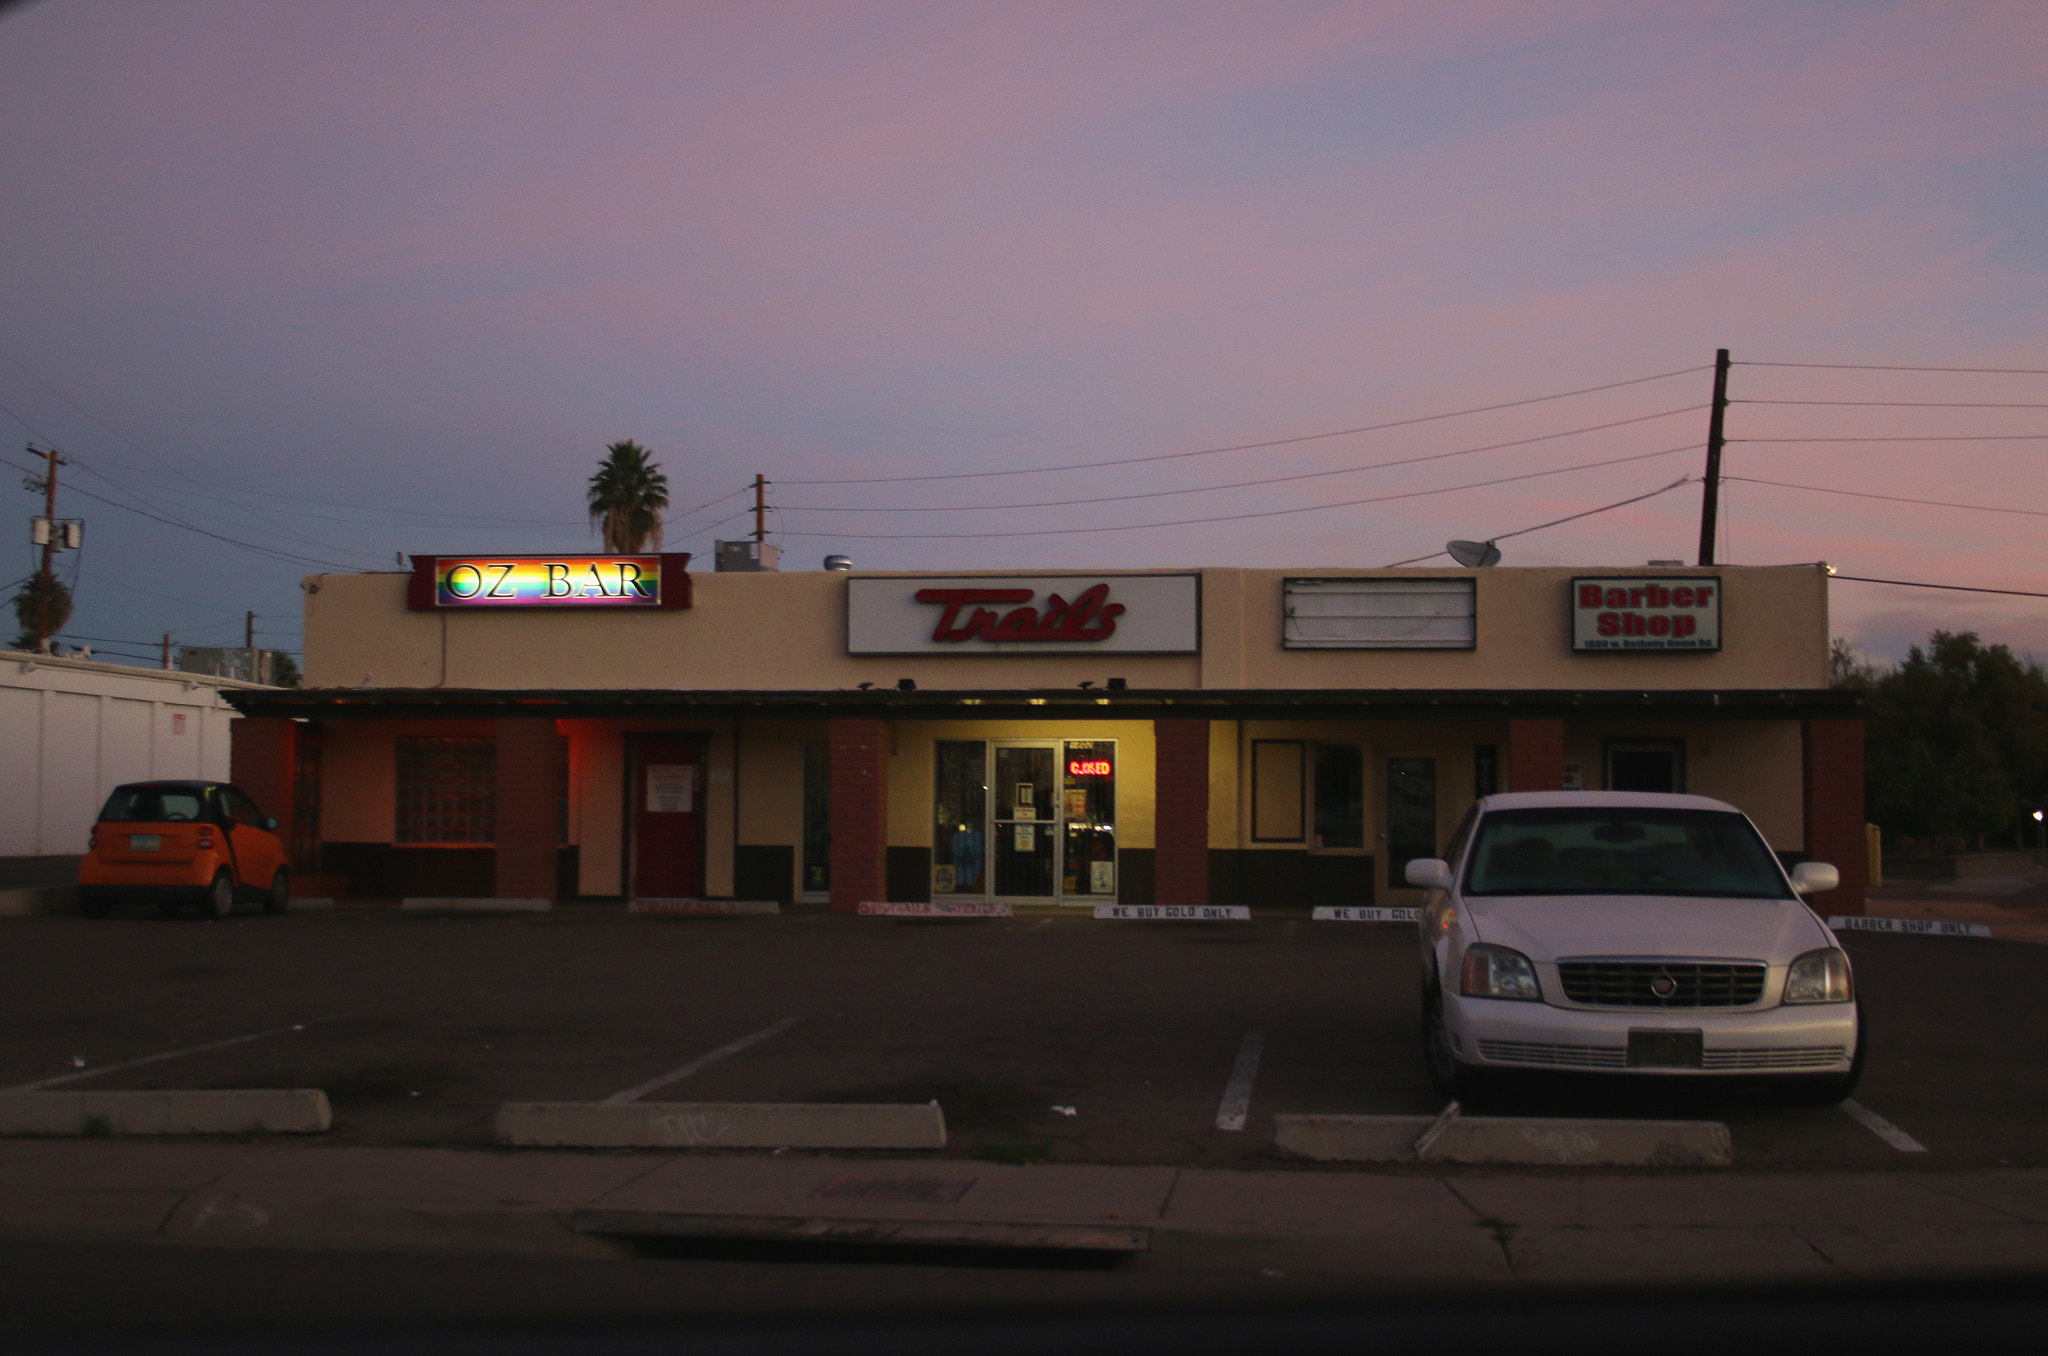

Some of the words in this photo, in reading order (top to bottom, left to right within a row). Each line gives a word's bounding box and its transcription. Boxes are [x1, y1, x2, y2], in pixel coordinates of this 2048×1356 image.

[445, 562, 518, 599] OZ
[541, 561, 652, 599] BAR
[1579, 583, 1714, 609] Barber
[915, 583, 1126, 642] Trails
[1597, 611, 1696, 638] Shop
[1069, 760, 1111, 775] CLOSED
[1112, 906, 1129, 918] WE
[1137, 906, 1160, 918] BUY
[1165, 906, 1196, 918] GOLD
[1203, 907, 1232, 919] ONLY
[1334, 908, 1350, 919] WE
[1359, 908, 1382, 920] BUY
[1844, 918, 1893, 931] BARBER
[1901, 920, 1933, 933] SHOP
[1941, 923, 1972, 936] ONLY
